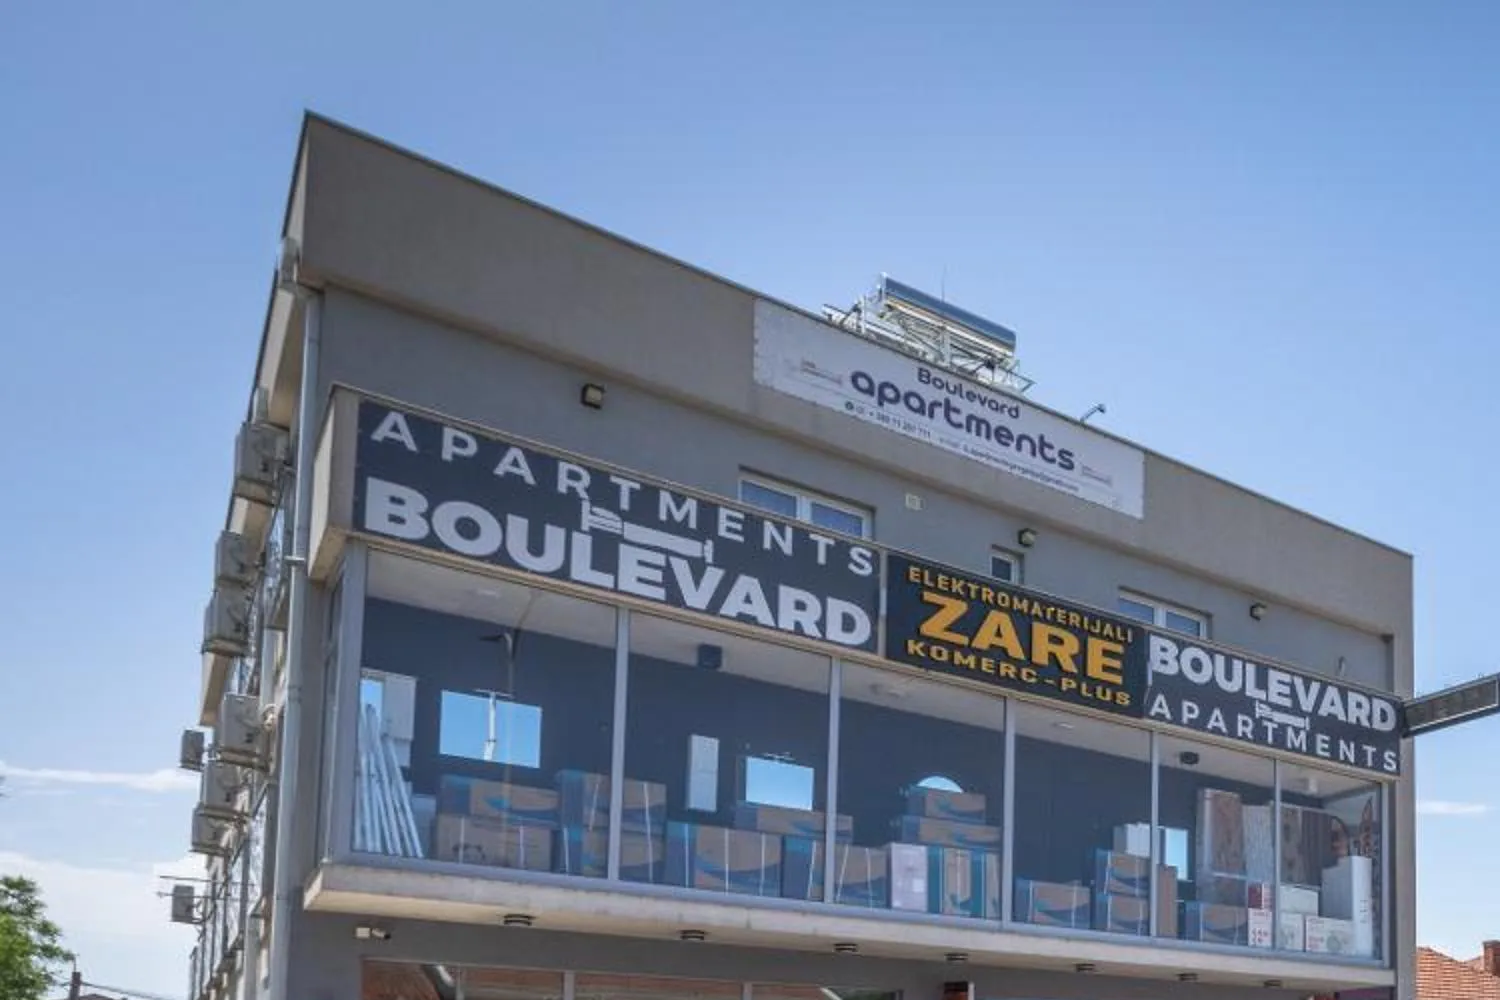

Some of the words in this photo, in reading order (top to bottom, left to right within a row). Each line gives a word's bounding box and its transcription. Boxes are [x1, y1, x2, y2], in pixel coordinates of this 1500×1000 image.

[850, 371, 1075, 471] apartments
[917, 366, 1020, 419] Boulevard
[371, 412, 873, 577] APARTMENTS
[364, 476, 872, 647] BOULEVARD
[909, 565, 1133, 643] ELEKTROMATERIJALI
[919, 591, 1124, 685] ZARE
[1149, 634, 1397, 732] BOULEVARD
[1149, 693, 1397, 771] APARTMENTS
